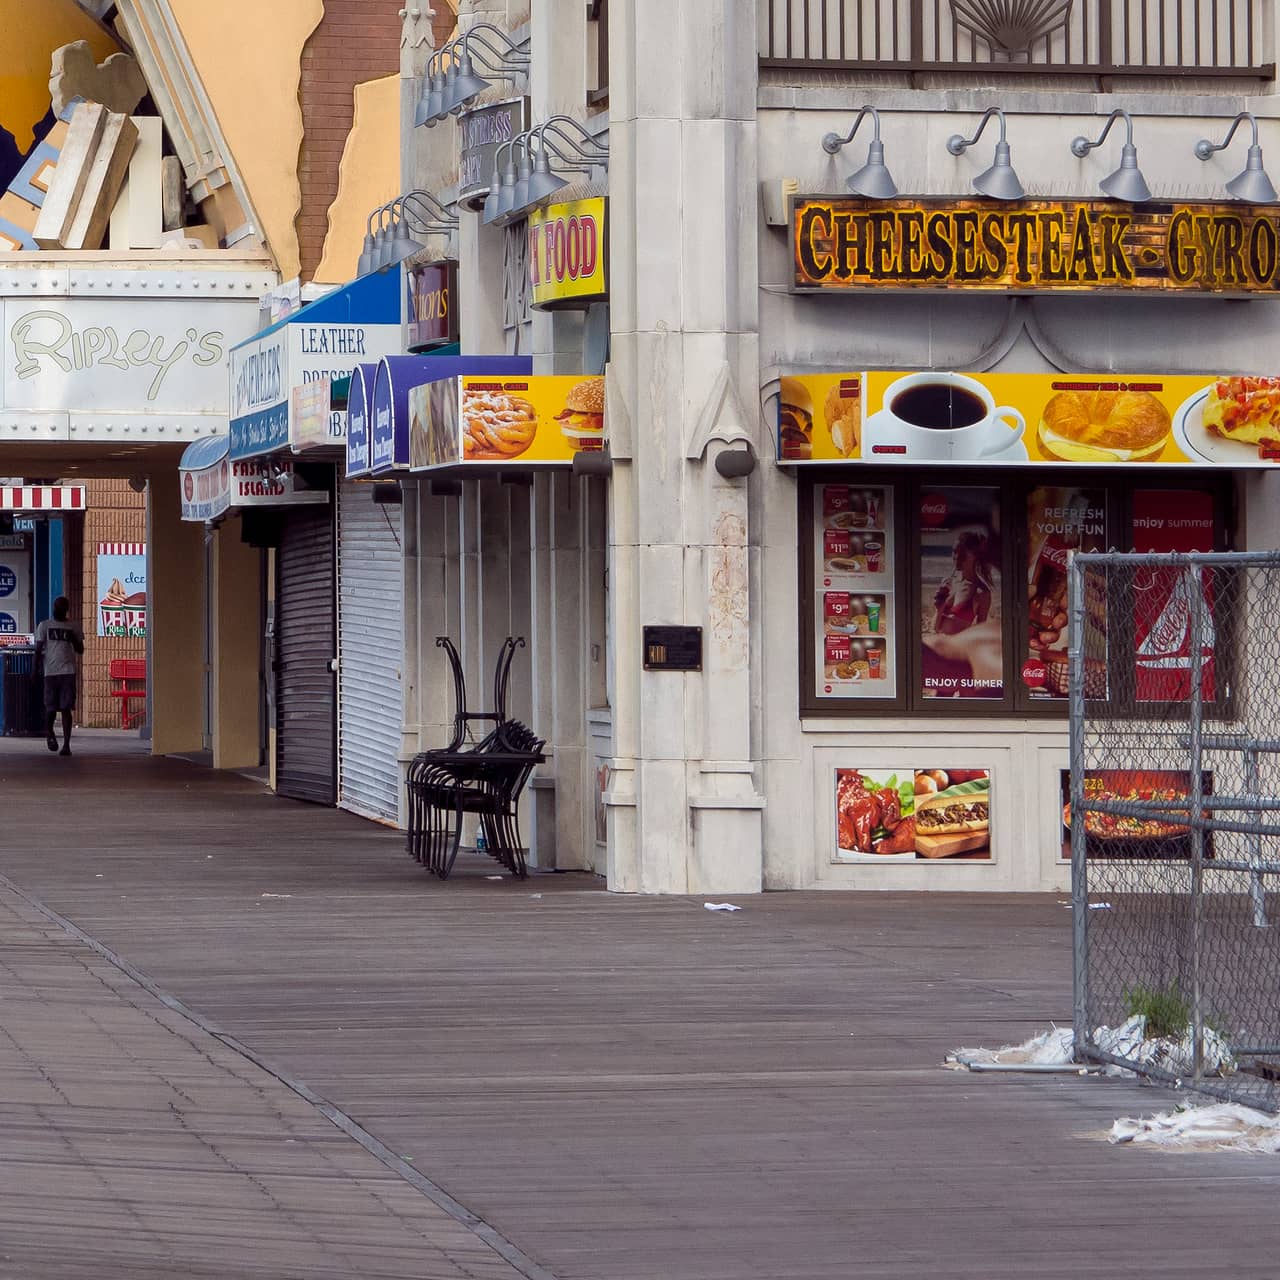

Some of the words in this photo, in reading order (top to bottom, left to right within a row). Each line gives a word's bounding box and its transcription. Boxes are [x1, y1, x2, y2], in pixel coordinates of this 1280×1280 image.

[545, 214, 597, 284] FOOD
[796, 205, 1135, 282] CHEESESTEAK
[300, 327, 366, 355] LEATHER
[1044, 507, 1104, 520] REFRESH
[1167, 517, 1213, 528] summer
[1036, 523, 1073, 535] YOUR
[1077, 523, 1104, 536] FUN
[925, 677, 959, 688] ENJOY
[960, 678, 1004, 689] SUMMER
